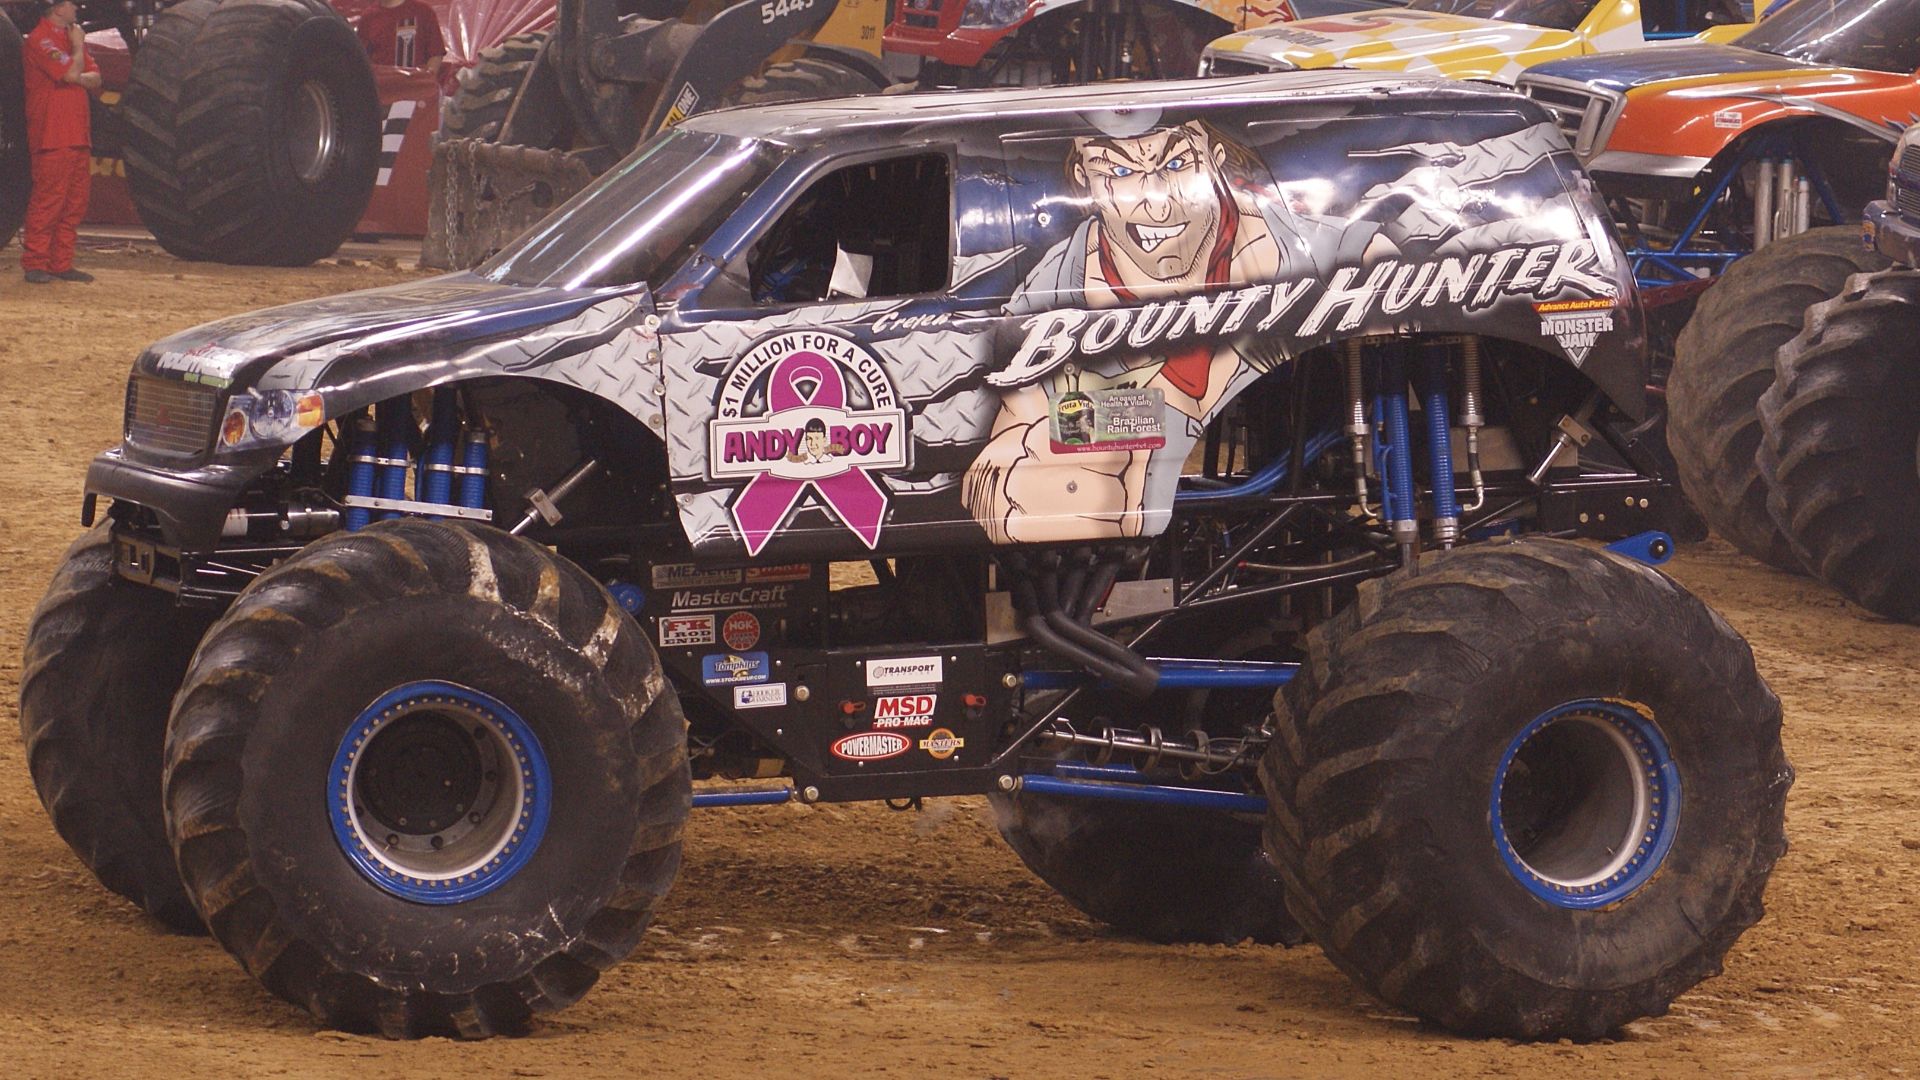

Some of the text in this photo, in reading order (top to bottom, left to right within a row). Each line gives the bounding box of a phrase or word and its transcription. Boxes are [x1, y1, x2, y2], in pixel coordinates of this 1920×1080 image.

[677, 87, 696, 115] ONE
[985, 239, 1619, 387] BOUNTY HUNTER
[1538, 300, 1608, 312] Advance Auto Parts
[1540, 317, 1613, 336] MONSTER
[1558, 333, 1596, 349] JAM
[723, 335, 892, 418] $1 MILLION FOR A CURE
[1101, 400, 1123, 408] Health
[1130, 399, 1153, 408] Vitality
[1107, 423, 1161, 434] Rain Forest
[1113, 416, 1155, 426] Brazilian
[724, 422, 893, 463] ANDY BOY
[671, 585, 787, 607] MasterCraft
[668, 618, 711, 632] FK
[664, 636, 712, 645] ENDS
[674, 630, 711, 638] ROD
[884, 664, 935, 675] TRANSPORT
[878, 696, 933, 717] MSD
[877, 716, 930, 728] PRO MAG
[841, 735, 903, 756] POWERMASTER
